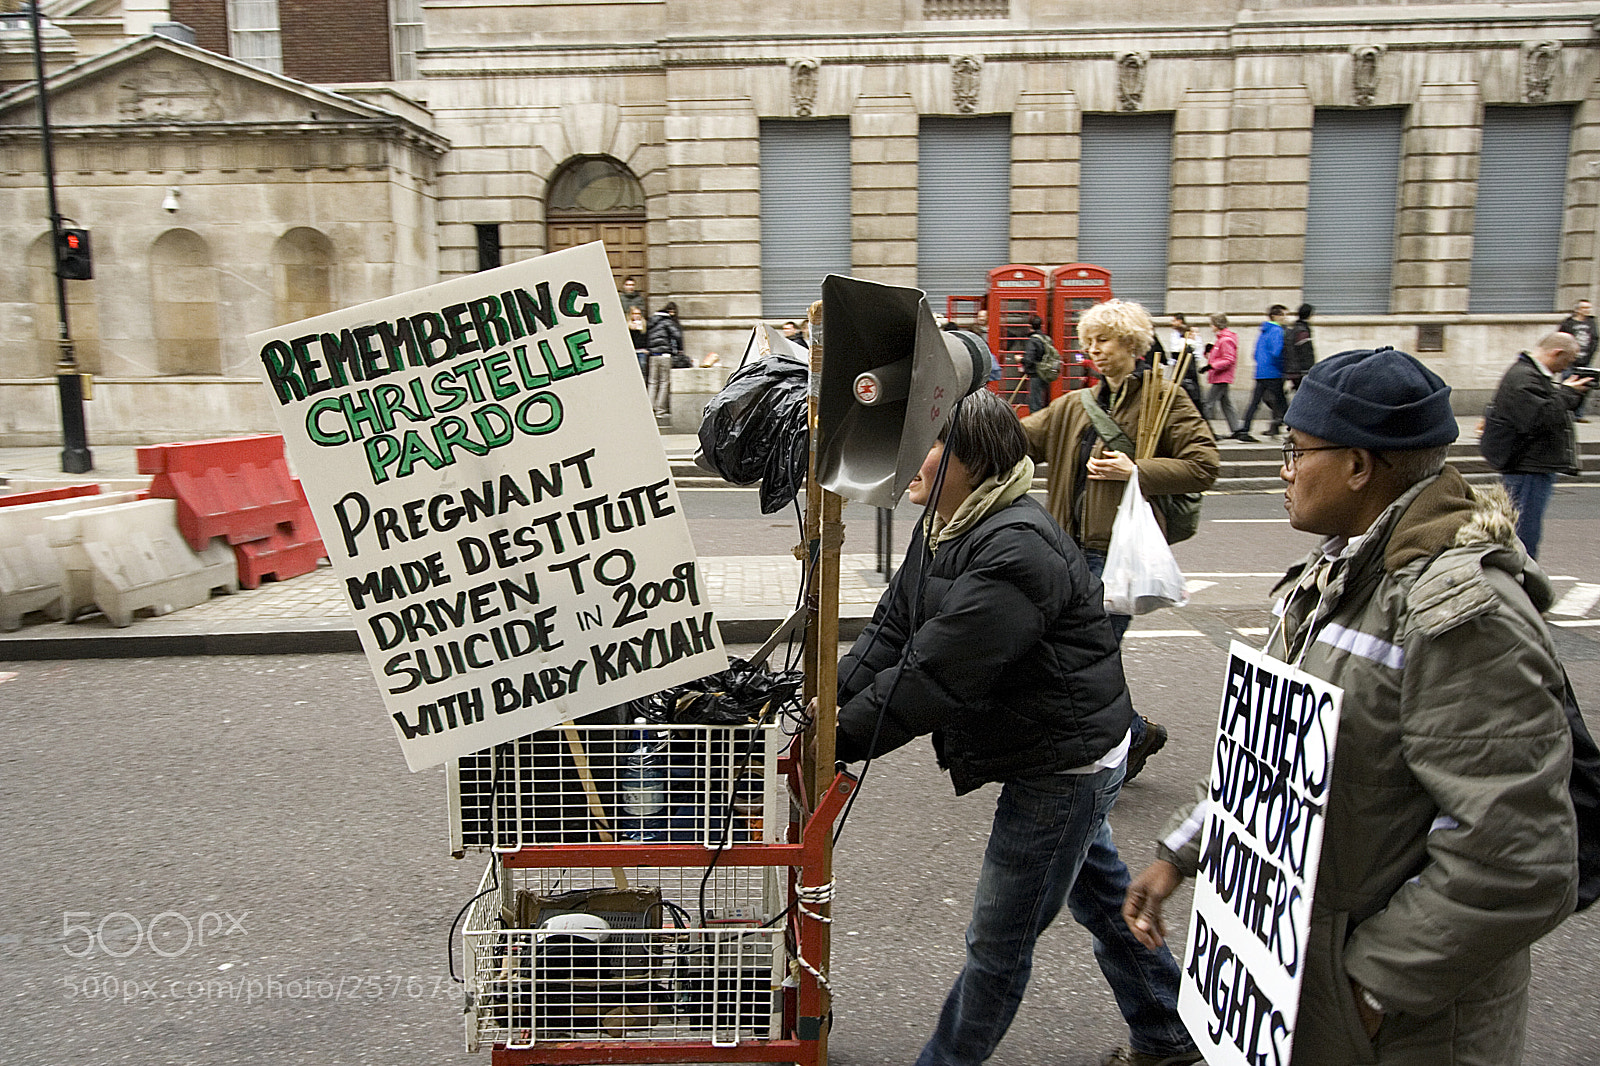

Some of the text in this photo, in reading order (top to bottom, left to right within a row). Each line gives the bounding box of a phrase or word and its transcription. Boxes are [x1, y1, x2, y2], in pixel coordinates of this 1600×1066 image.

[260, 281, 603, 405] REMEMBERING
[305, 329, 605, 447] CHRISTELLE
[363, 391, 564, 485] PARDO
[333, 448, 597, 558] PREGNANT
[346, 477, 677, 611] MADE DESTITUTE
[369, 549, 634, 651] DRIVEN TO
[383, 561, 701, 696] SUICIDE IN 2009
[393, 686, 485, 741] WITH
[493, 659, 587, 715] BABY
[1220, 654, 1334, 799] FATHERS
[1211, 733, 1322, 883] SUPPORT
[1199, 814, 1302, 979] MOTHERS
[1186, 910, 1293, 1066] RIGHTS
